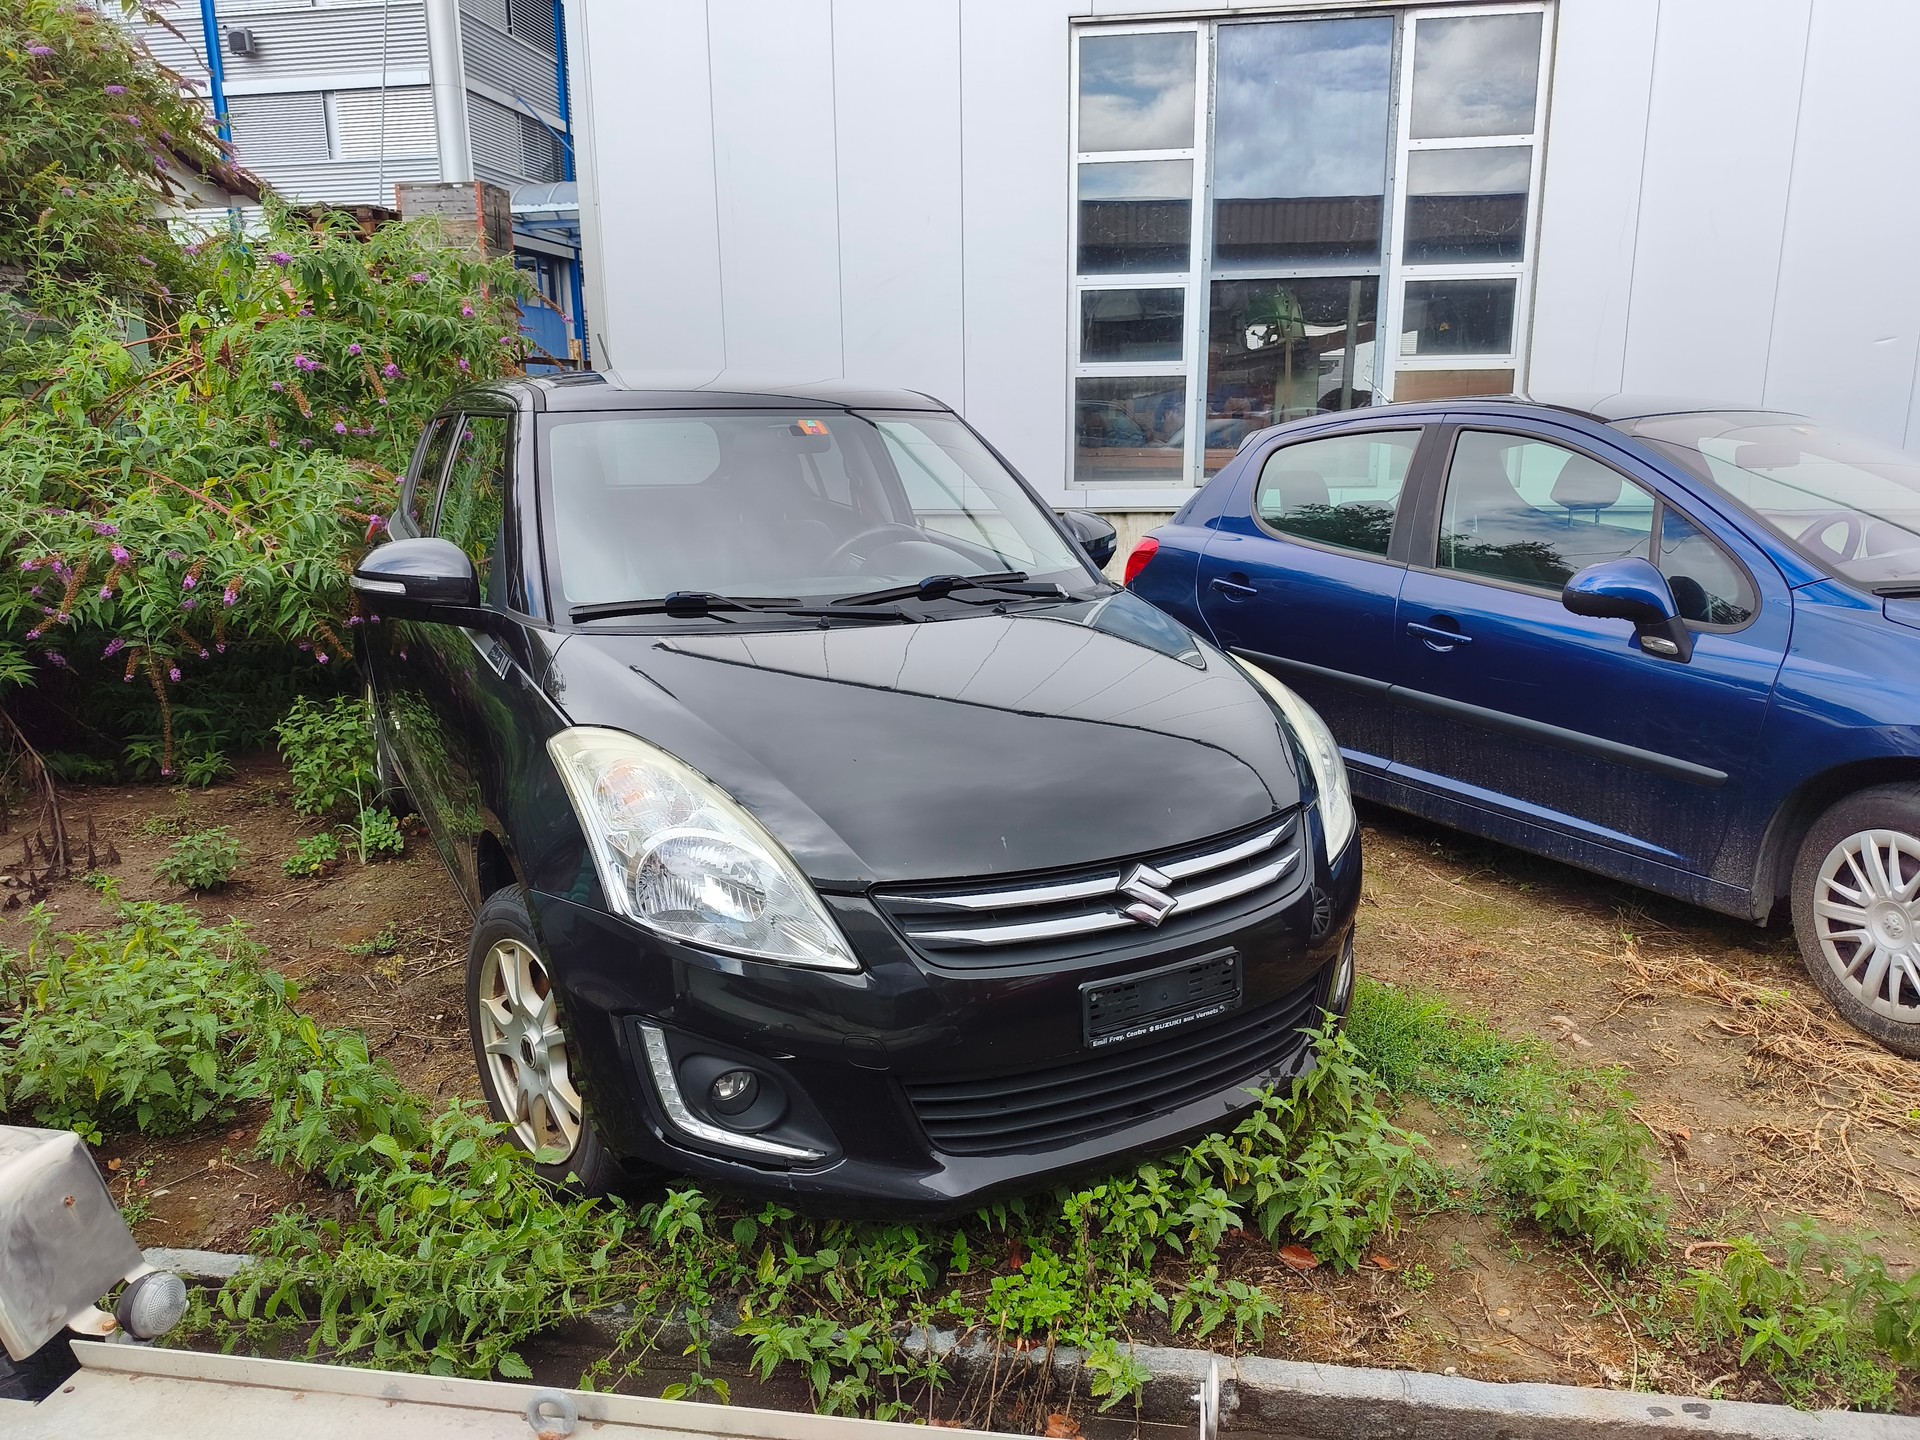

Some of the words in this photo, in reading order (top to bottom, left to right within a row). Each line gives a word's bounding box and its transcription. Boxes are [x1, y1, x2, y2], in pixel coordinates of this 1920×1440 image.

[1093, 1038, 1108, 1047] Emil
[1126, 1028, 1147, 1038] Centre
[1154, 1018, 1182, 1031] SUZUKI
